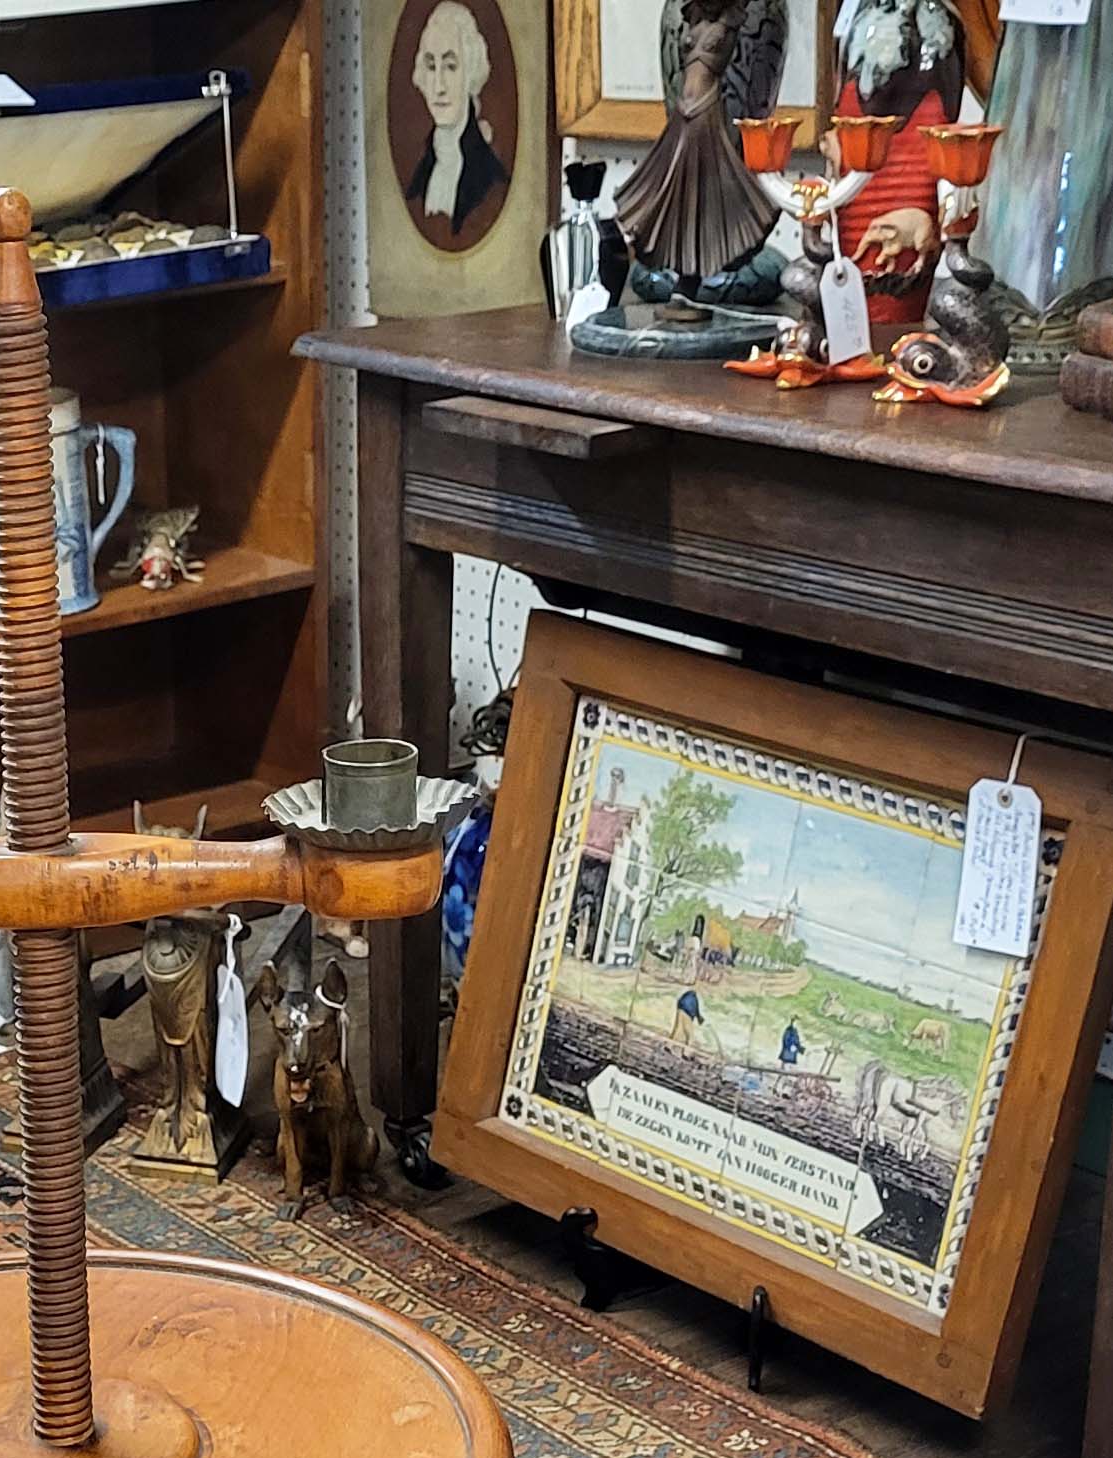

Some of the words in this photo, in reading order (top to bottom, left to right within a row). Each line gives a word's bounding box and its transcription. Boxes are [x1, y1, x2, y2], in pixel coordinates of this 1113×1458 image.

[634, 1113, 672, 1139] ZEGEN
[675, 1130, 713, 1154] KOMT
[716, 1148, 742, 1170] VAN
[744, 1160, 798, 1193] HOOGER
[672, 1106, 710, 1131] PLOEG
[713, 1122, 747, 1148] NAAR
